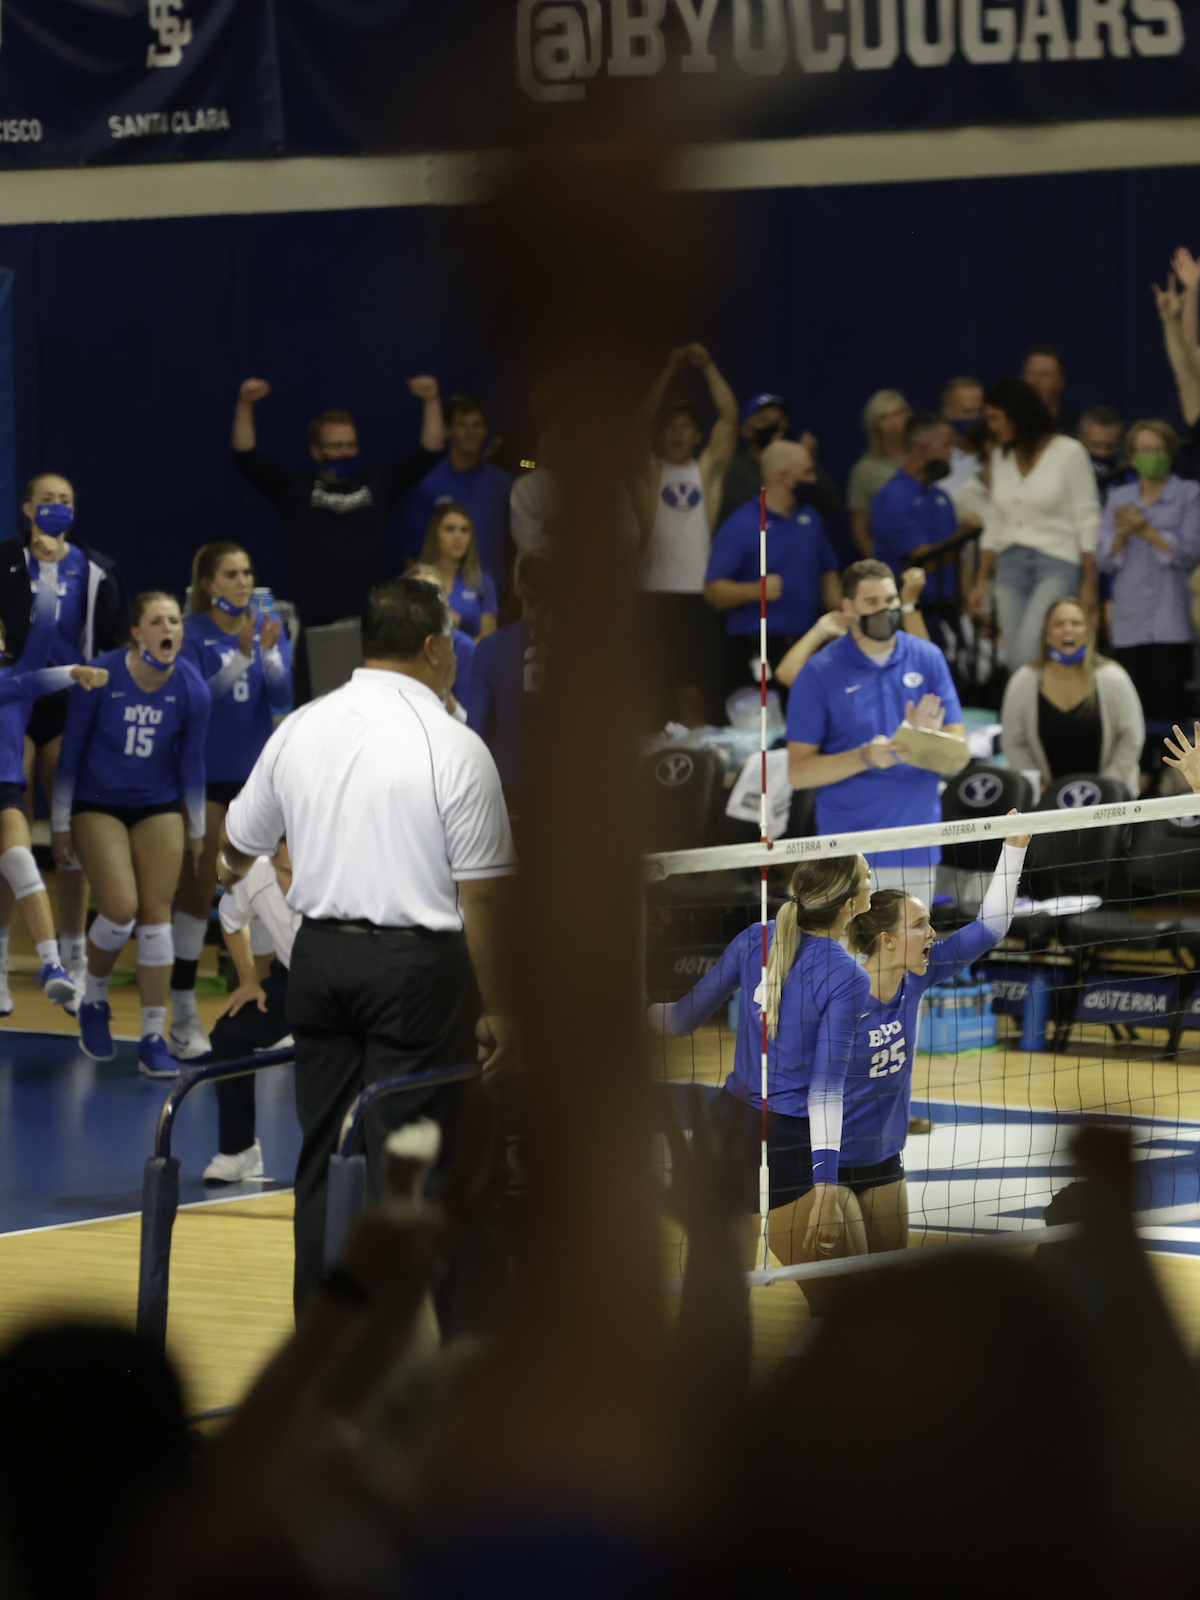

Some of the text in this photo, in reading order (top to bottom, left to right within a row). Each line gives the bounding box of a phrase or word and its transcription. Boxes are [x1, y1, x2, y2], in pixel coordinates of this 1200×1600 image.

[108, 107, 231, 138] SANTA CLARA
[124, 704, 163, 725] BYU
[124, 725, 156, 758] 15
[869, 1037, 907, 1078] 25
